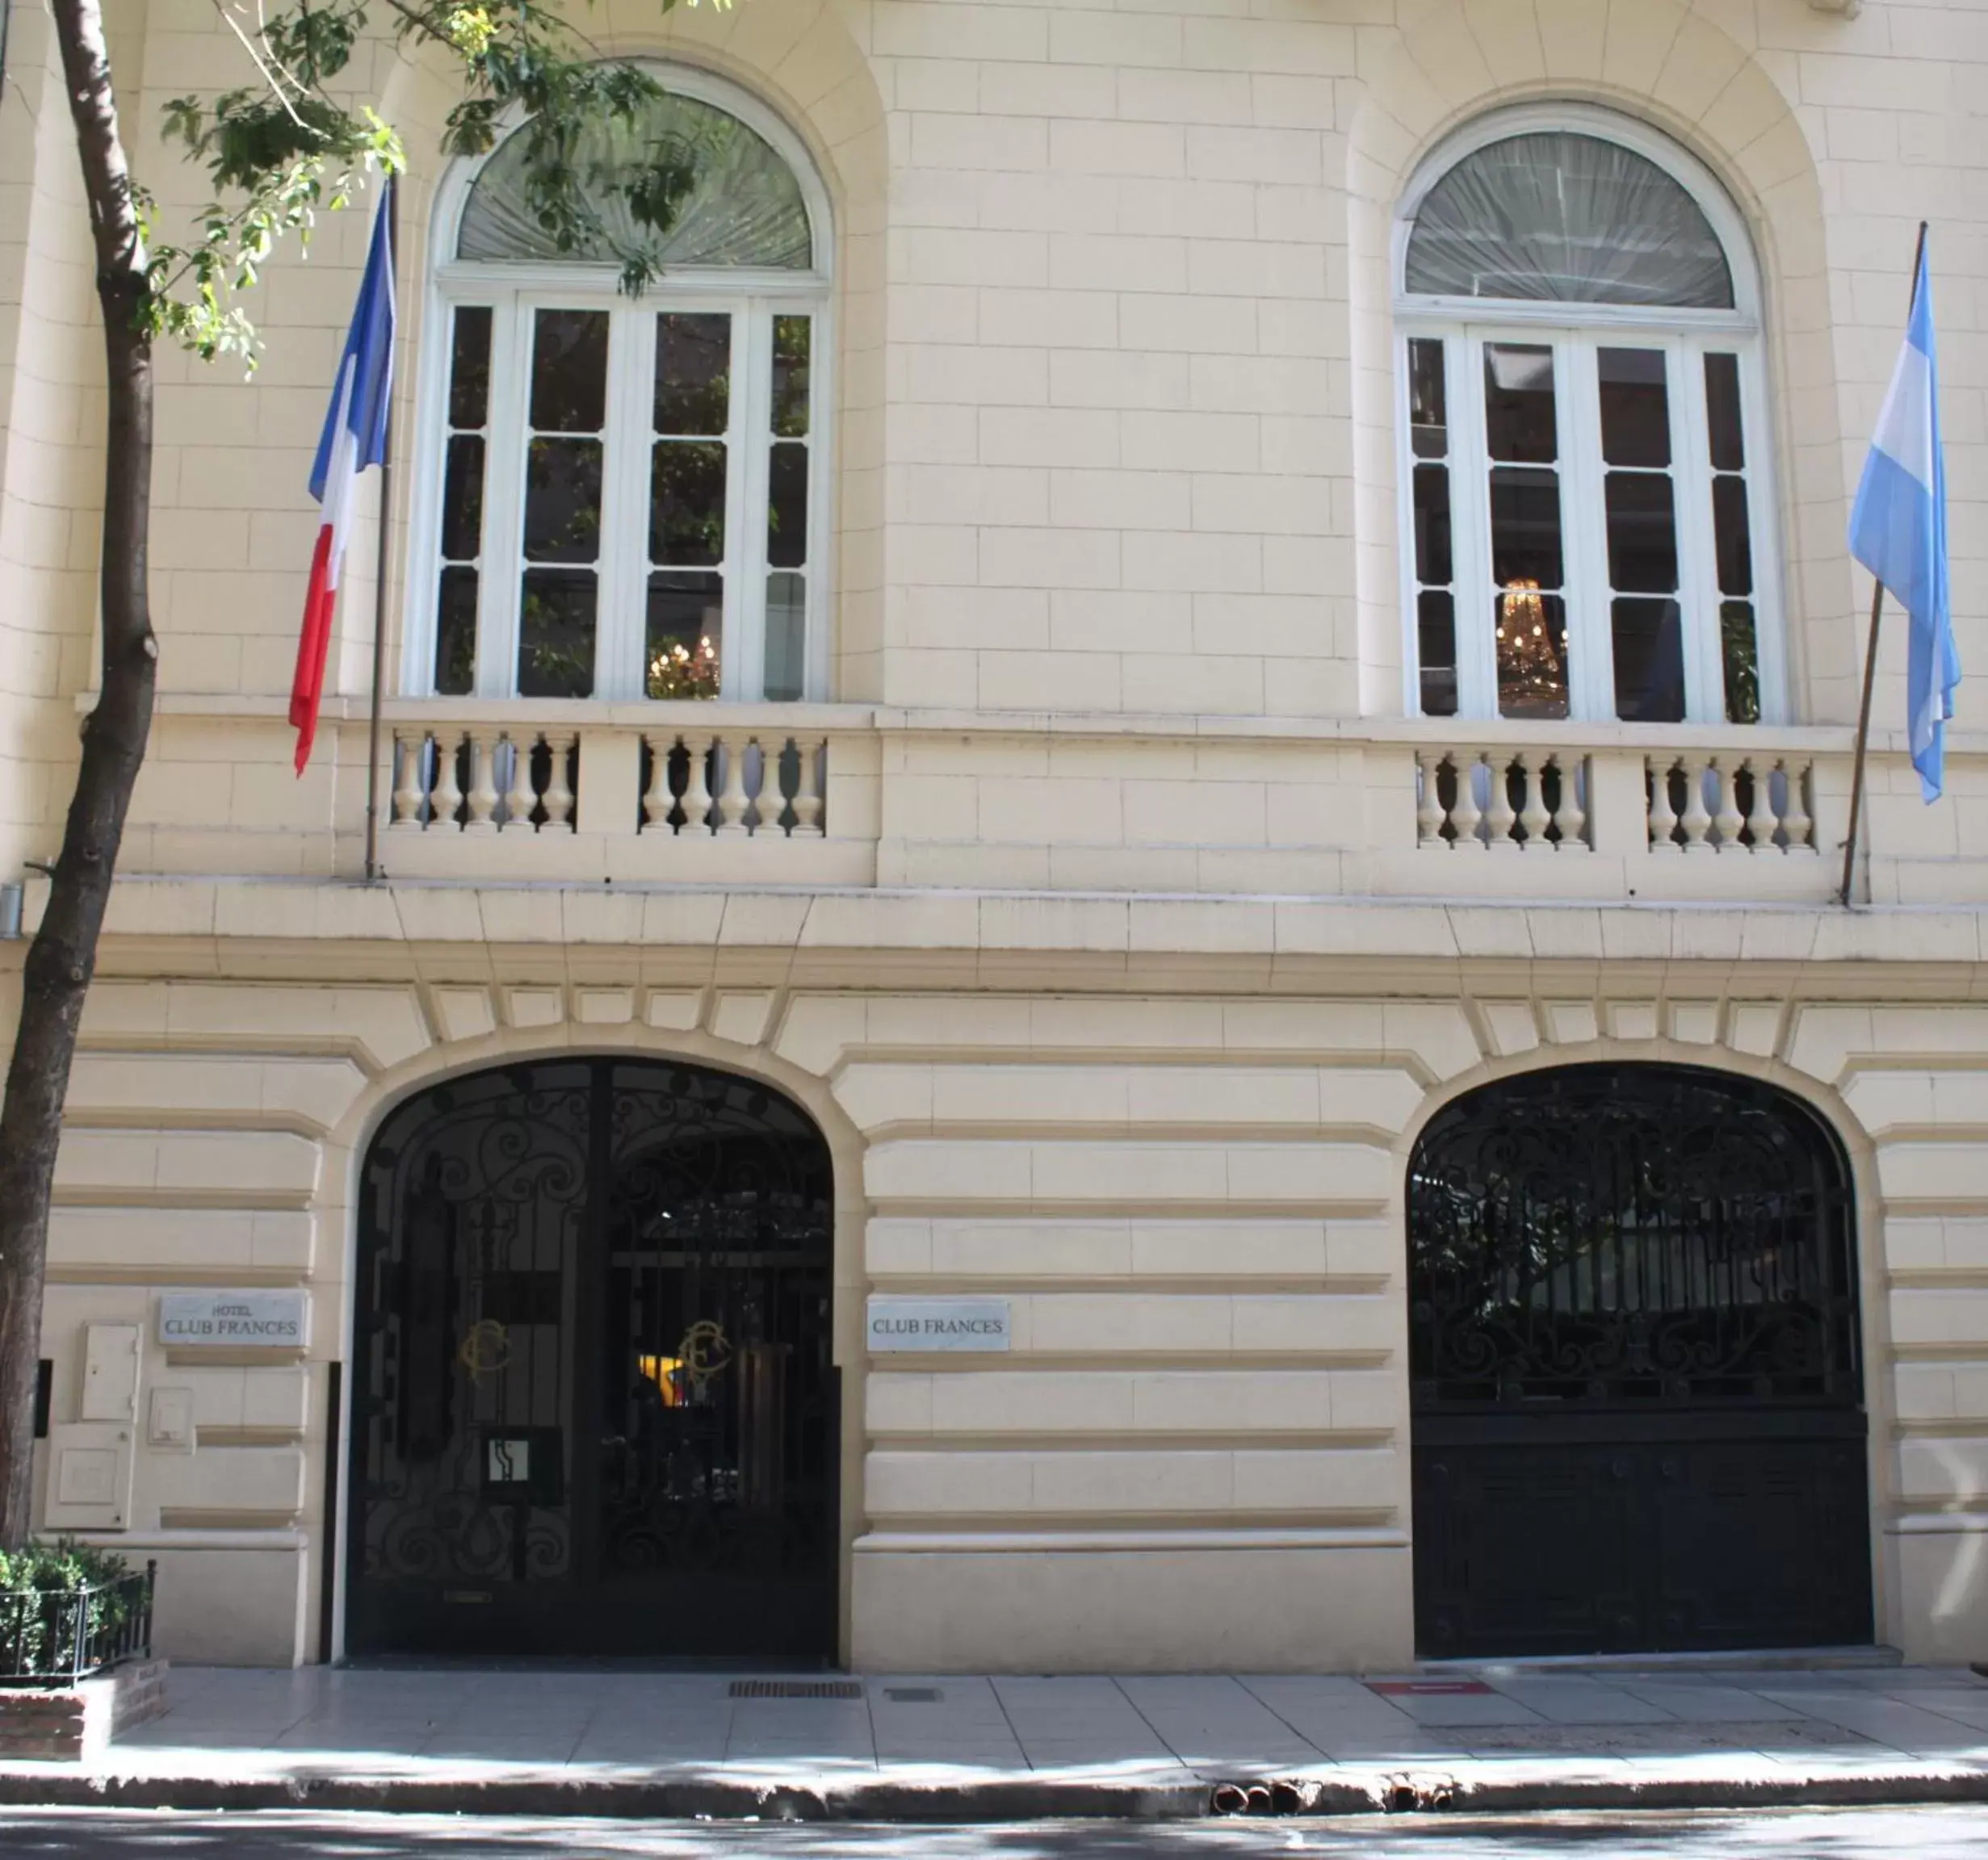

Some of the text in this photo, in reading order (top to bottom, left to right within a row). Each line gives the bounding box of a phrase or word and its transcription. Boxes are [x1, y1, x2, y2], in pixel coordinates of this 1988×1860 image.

[212, 1305, 252, 1317] HOTEL
[165, 1319, 297, 1335] CLUB FRANCES
[872, 1318, 1004, 1334] CLUB FRANCES
